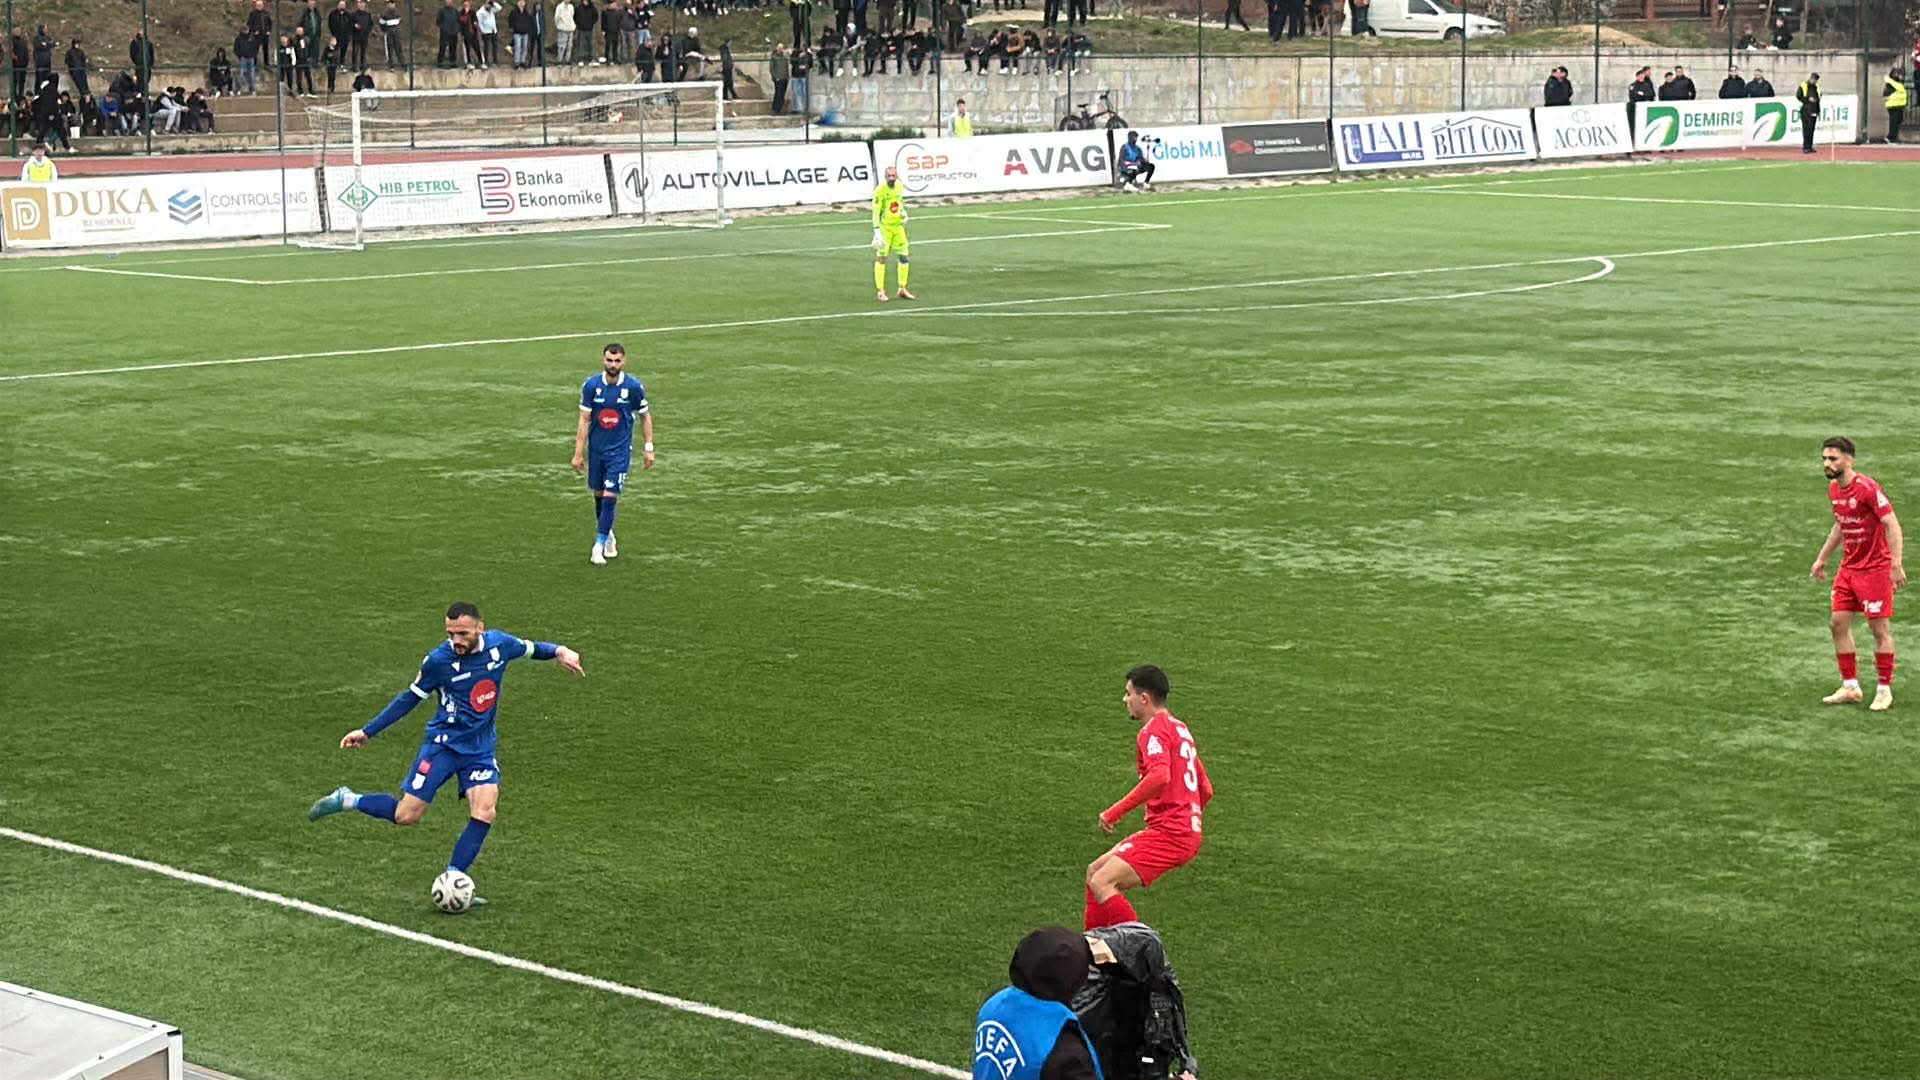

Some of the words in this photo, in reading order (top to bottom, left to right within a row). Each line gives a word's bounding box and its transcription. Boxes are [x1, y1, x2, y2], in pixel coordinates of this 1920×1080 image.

[1684, 111, 1735, 128] DEMIRI
[1554, 124, 1618, 149] ACORN
[1152, 139, 1195, 160] Globi
[380, 182, 403, 193] HIB
[407, 180, 460, 192] PETROL
[515, 171, 563, 186] Banka
[662, 168, 828, 191] AUTOVILLAGE
[837, 165, 868, 181] AG
[907, 172, 977, 182] CONSTRUCTION
[52, 187, 159, 217] DUKA
[519, 189, 603, 208] Ekonomike
[975, 1027, 1018, 1078] UEFA
